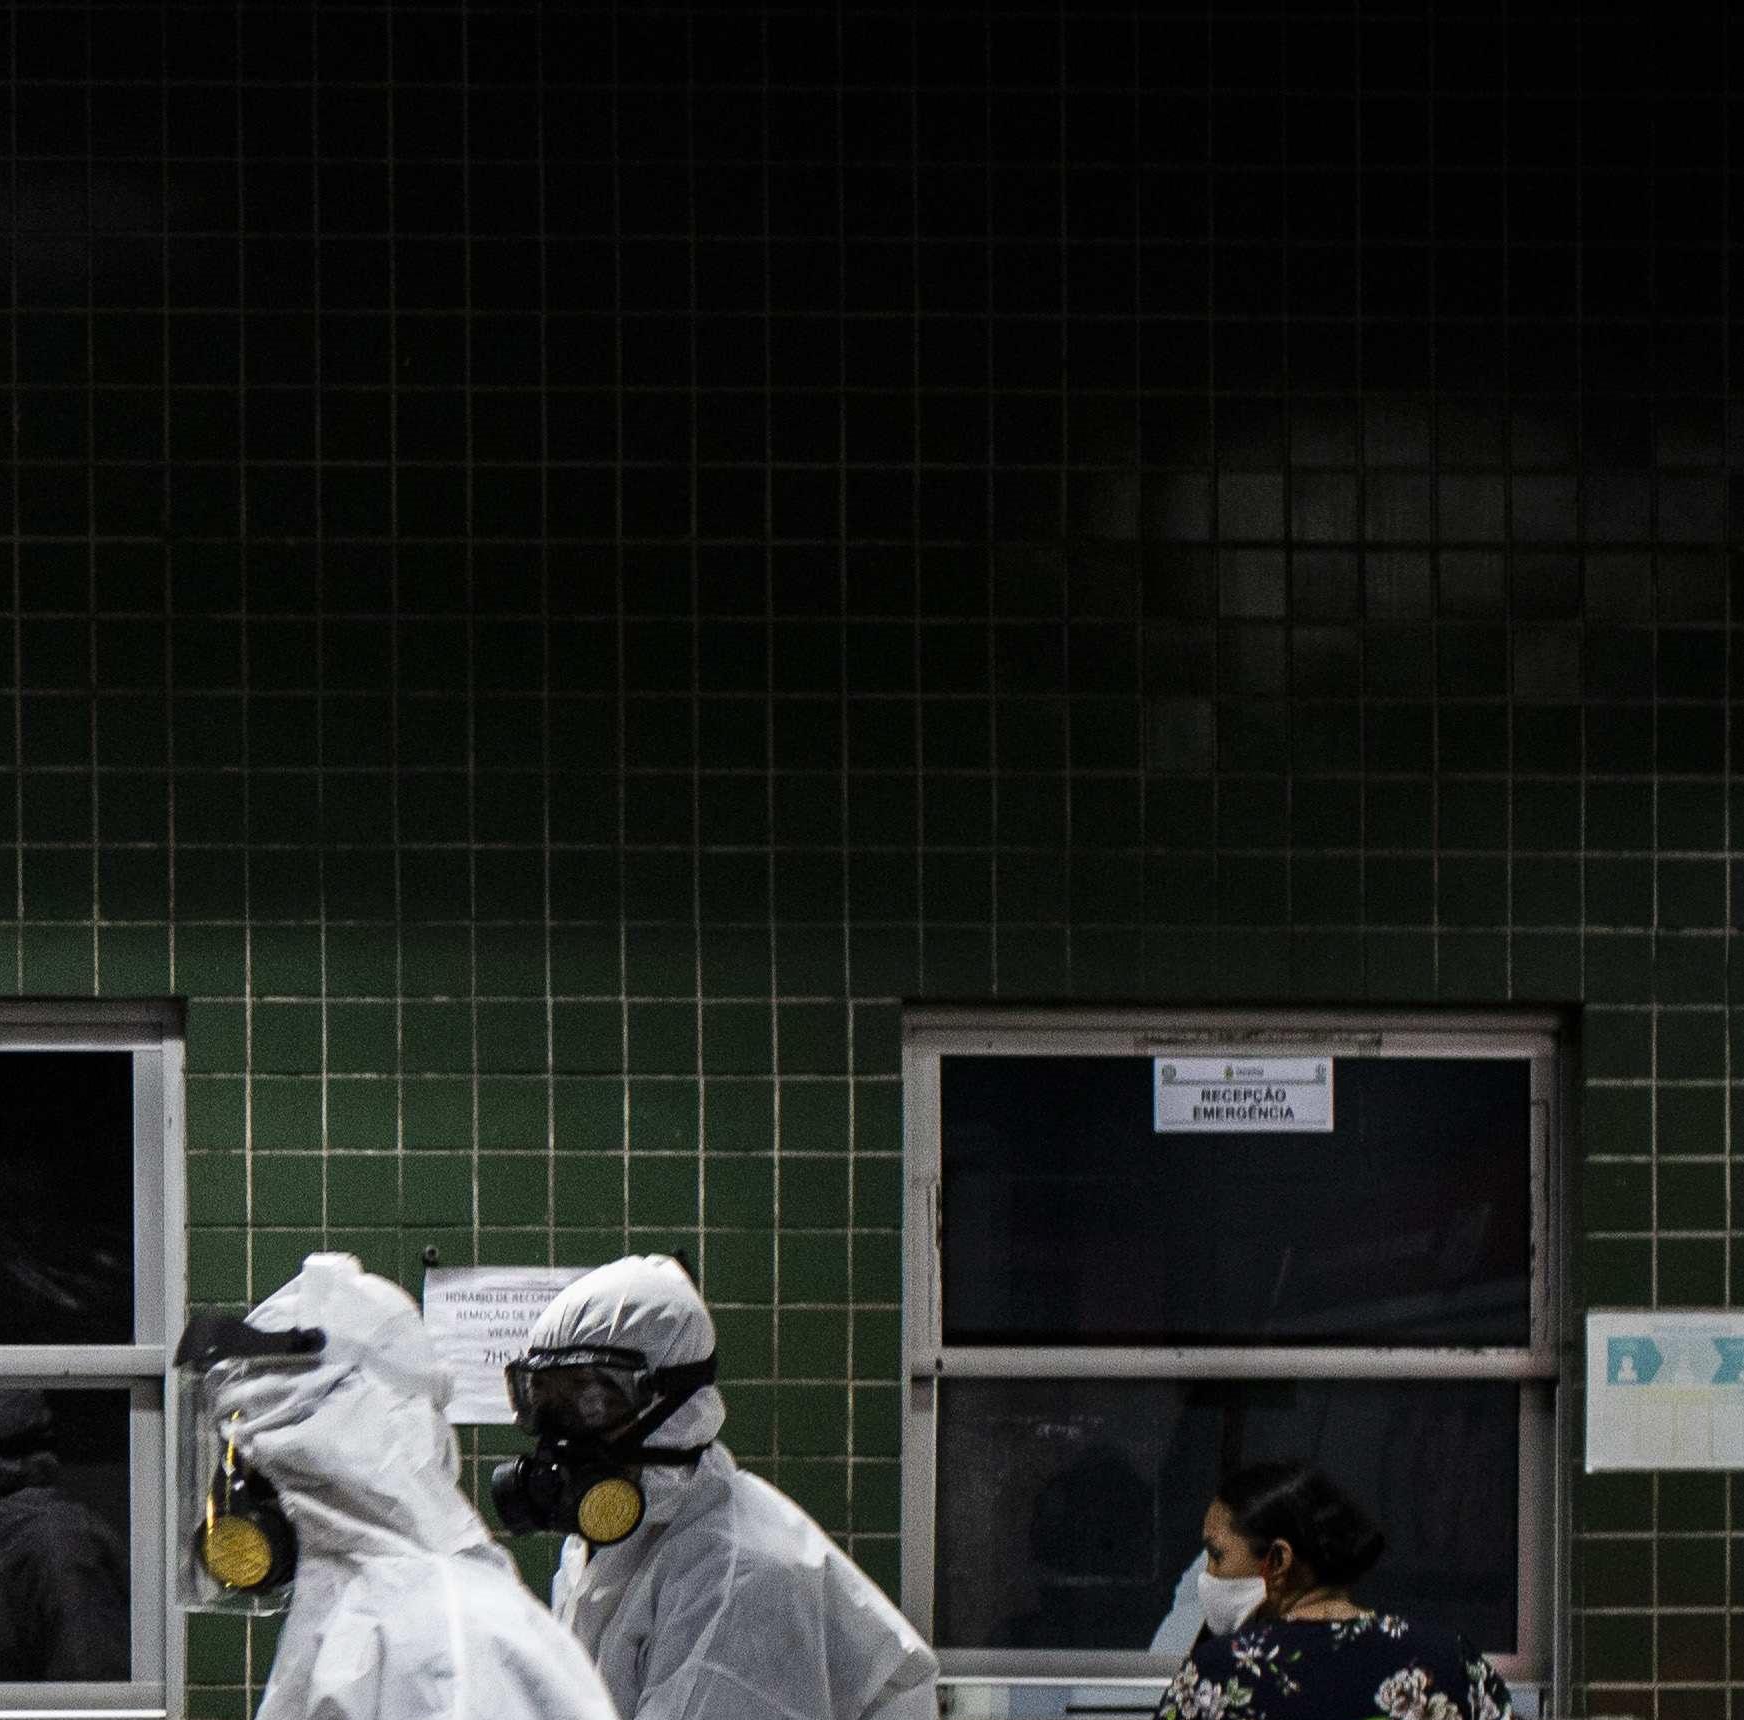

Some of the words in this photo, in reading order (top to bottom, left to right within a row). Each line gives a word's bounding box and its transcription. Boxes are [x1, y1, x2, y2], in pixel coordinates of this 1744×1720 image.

[1200, 1085, 1287, 1104] RECEPÇÃO
[1192, 1104, 1295, 1121] EMERGÊNCIA
[495, 1292, 509, 1303] DE
[456, 1309, 510, 1321] REMOÇÃO
[512, 1310, 525, 1320] DE
